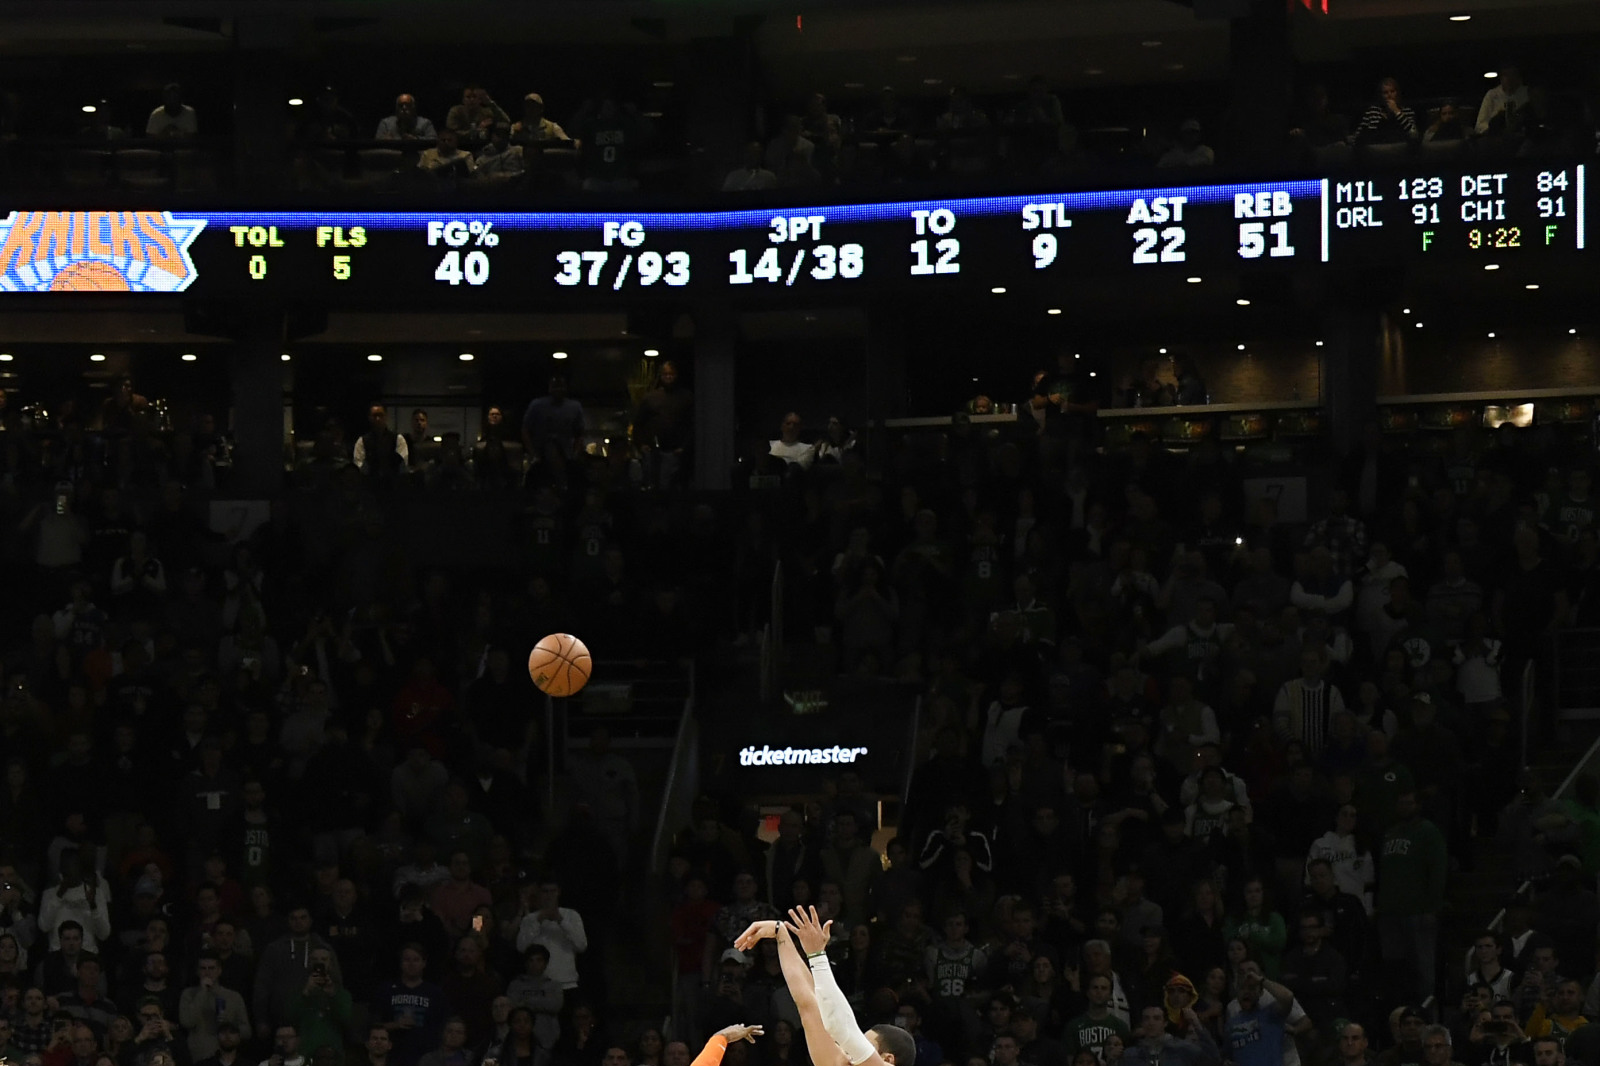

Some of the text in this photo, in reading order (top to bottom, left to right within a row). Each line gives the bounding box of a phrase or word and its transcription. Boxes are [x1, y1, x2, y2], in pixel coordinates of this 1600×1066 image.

[1336, 171, 1569, 203] MIL 123 DET 84
[1022, 203, 1072, 229] STL
[1126, 197, 1188, 224] AST
[1234, 192, 1293, 219] REB
[1336, 196, 1567, 229] ORL 91 CHI 91
[427, 221, 499, 248] FG%
[603, 222, 646, 247] FG
[768, 215, 826, 243] 3PT
[911, 209, 956, 234] TO
[230, 226, 285, 246] TOL
[316, 226, 367, 247] FLS
[1132, 228, 1186, 264] 22
[1238, 223, 1295, 259] 51
[1423, 225, 1557, 252] F 9:22 F
[728, 243, 865, 286] 14/38
[909, 239, 960, 275] 12
[1032, 234, 1058, 269] 9
[249, 257, 267, 280] 0
[332, 256, 351, 281] 5
[435, 251, 489, 285] 40
[554, 251, 690, 289] 37/93
[739, 745, 861, 766] ticketmaster
[937, 964, 968, 980] BOSTON
[940, 979, 964, 996] 36
[391, 995, 430, 1008] HORNETS
